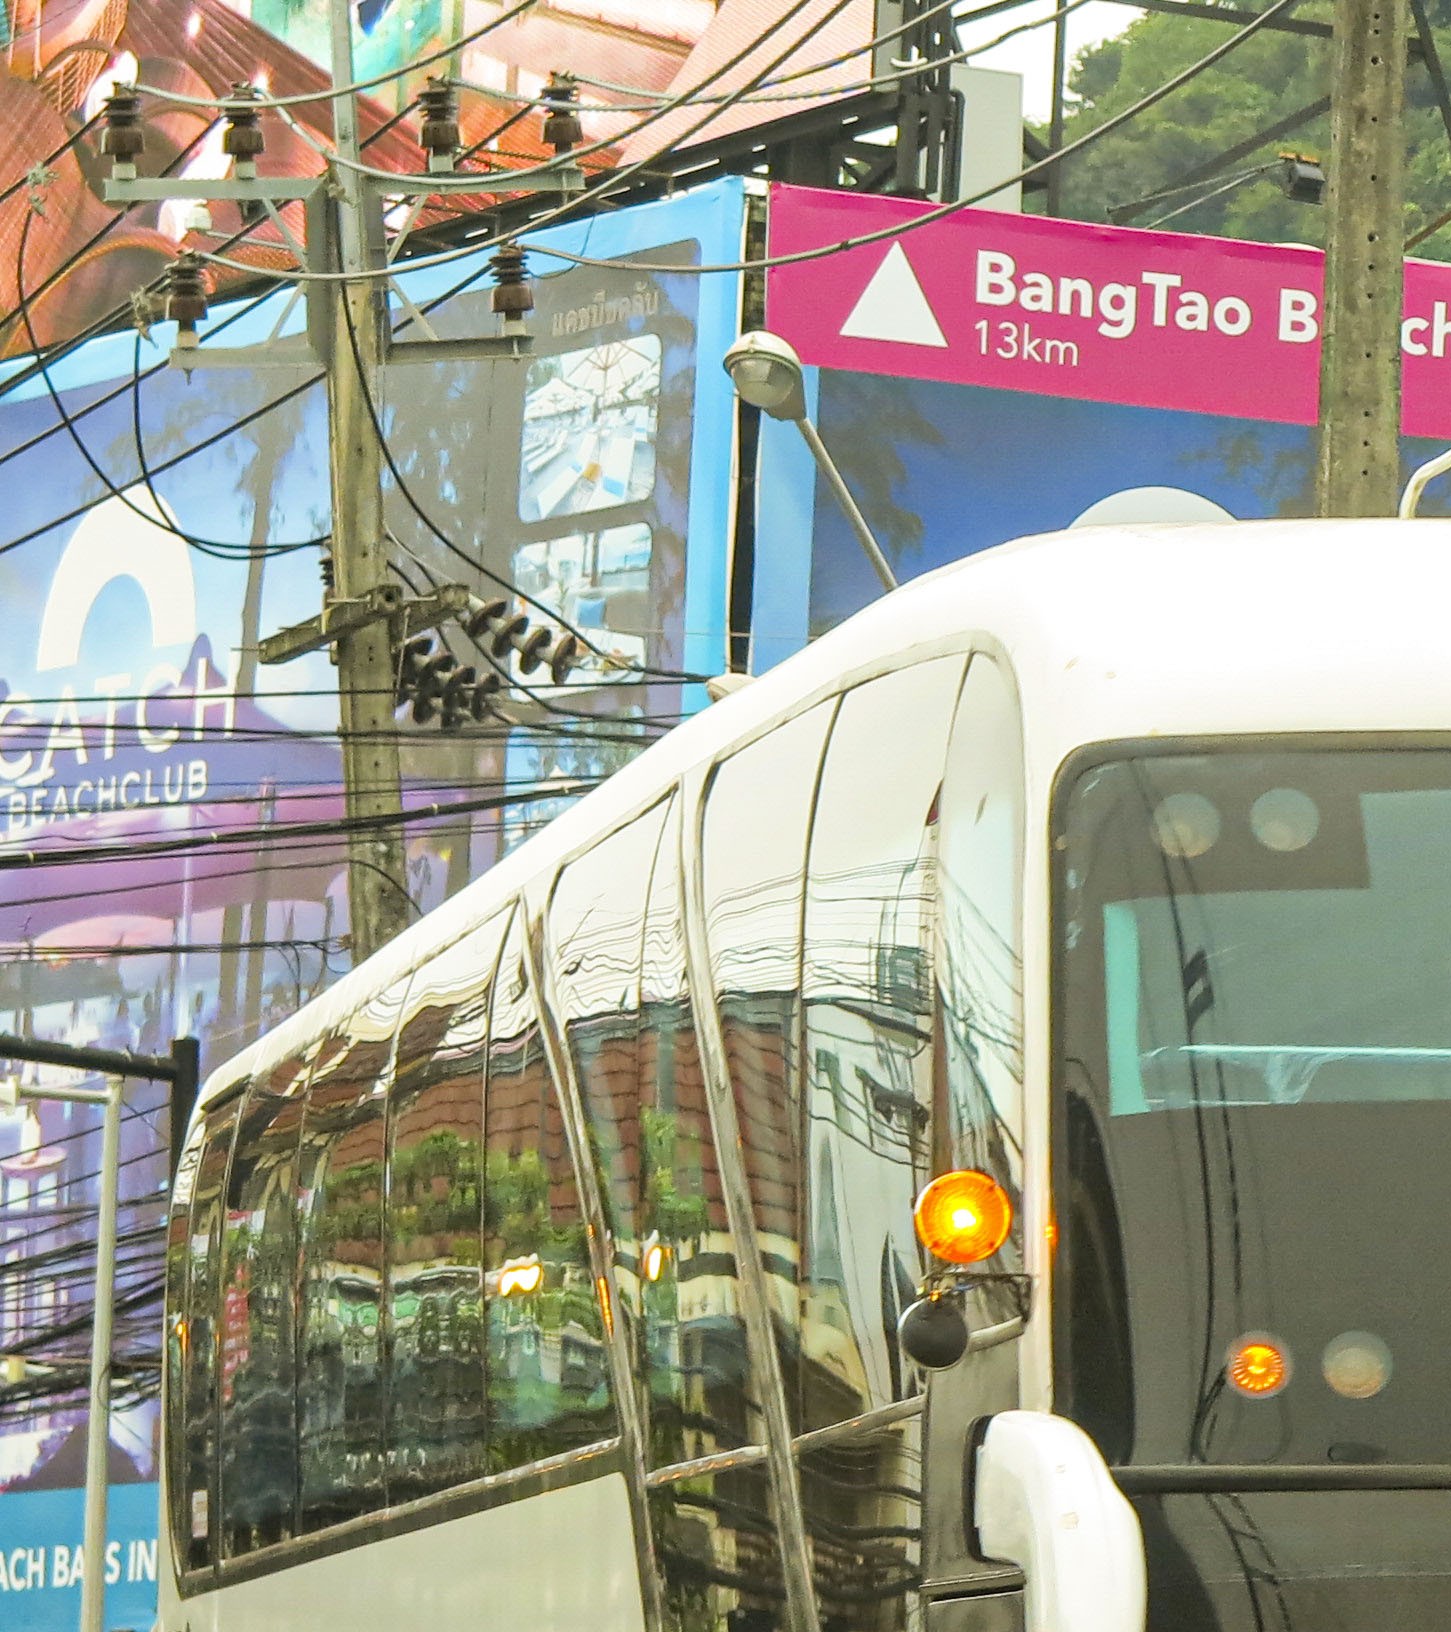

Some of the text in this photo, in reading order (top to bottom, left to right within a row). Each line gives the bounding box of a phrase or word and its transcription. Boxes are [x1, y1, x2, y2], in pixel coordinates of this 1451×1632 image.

[976, 249, 1252, 339] BangTao
[974, 319, 1080, 367] 13km
[0, 650, 242, 782] CATCH
[8, 759, 209, 832] BEACHCLUB
[52, 1540, 122, 1589] BAS
